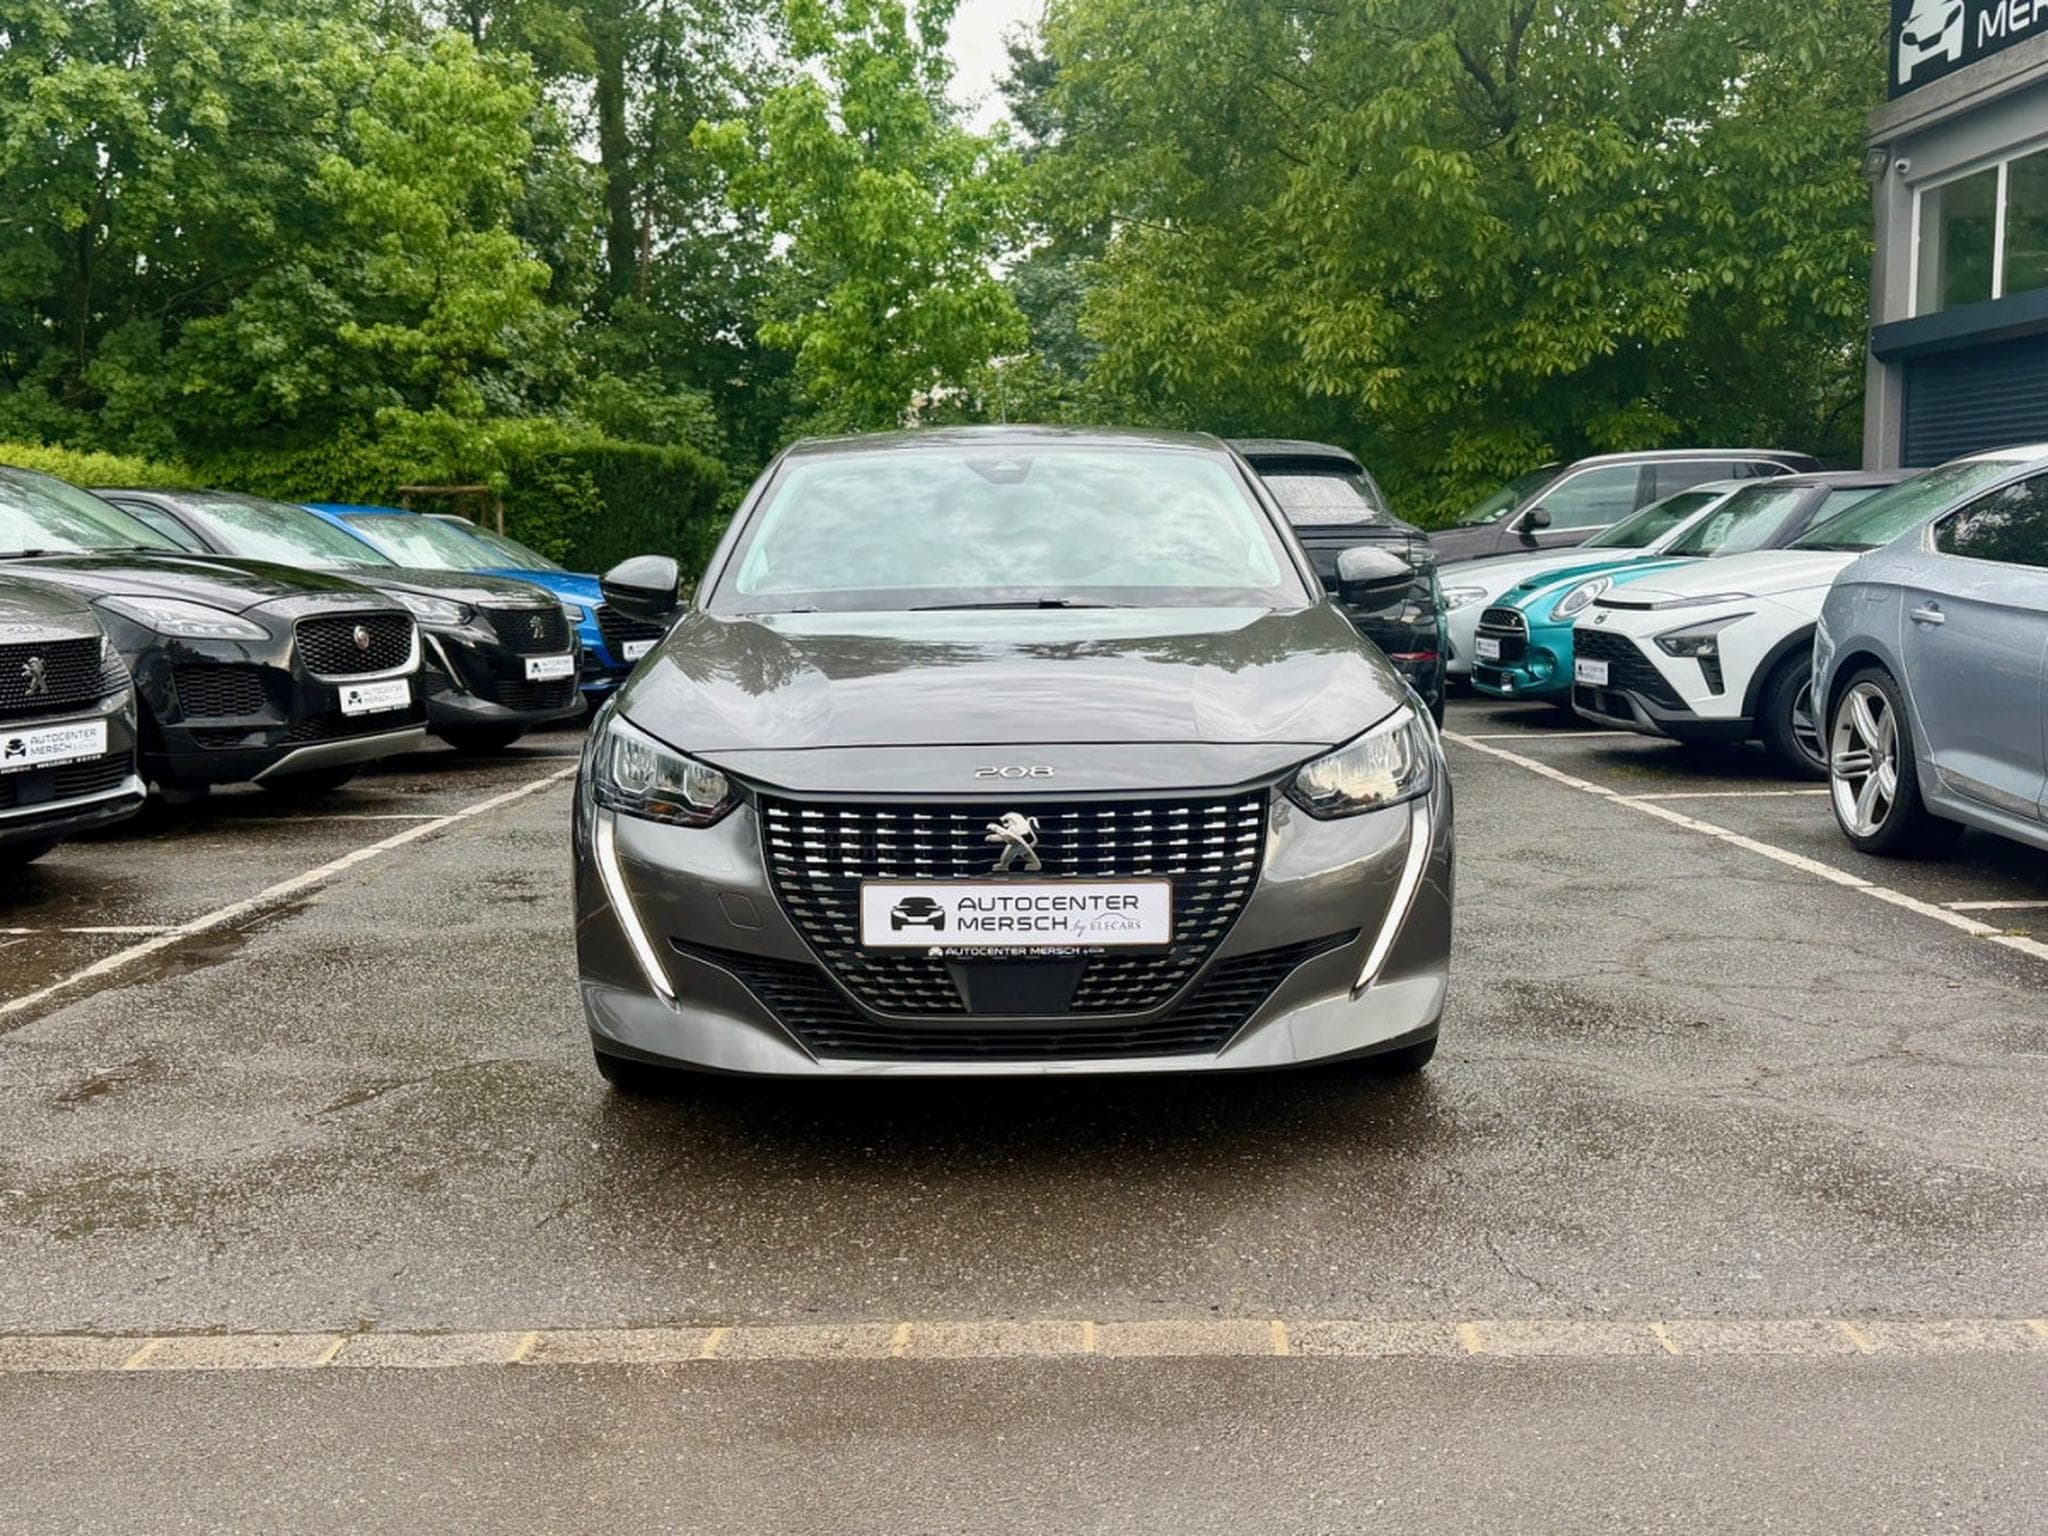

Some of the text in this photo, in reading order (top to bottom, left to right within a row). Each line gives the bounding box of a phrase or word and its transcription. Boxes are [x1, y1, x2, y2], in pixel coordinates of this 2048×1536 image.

[974, 765, 1055, 779] 208
[957, 894, 1139, 912] AUTOCENTER
[957, 916, 1068, 932] MERSCH
[944, 947, 1027, 956] AUTOCENTER
[1029, 947, 1082, 956] MERSCH
